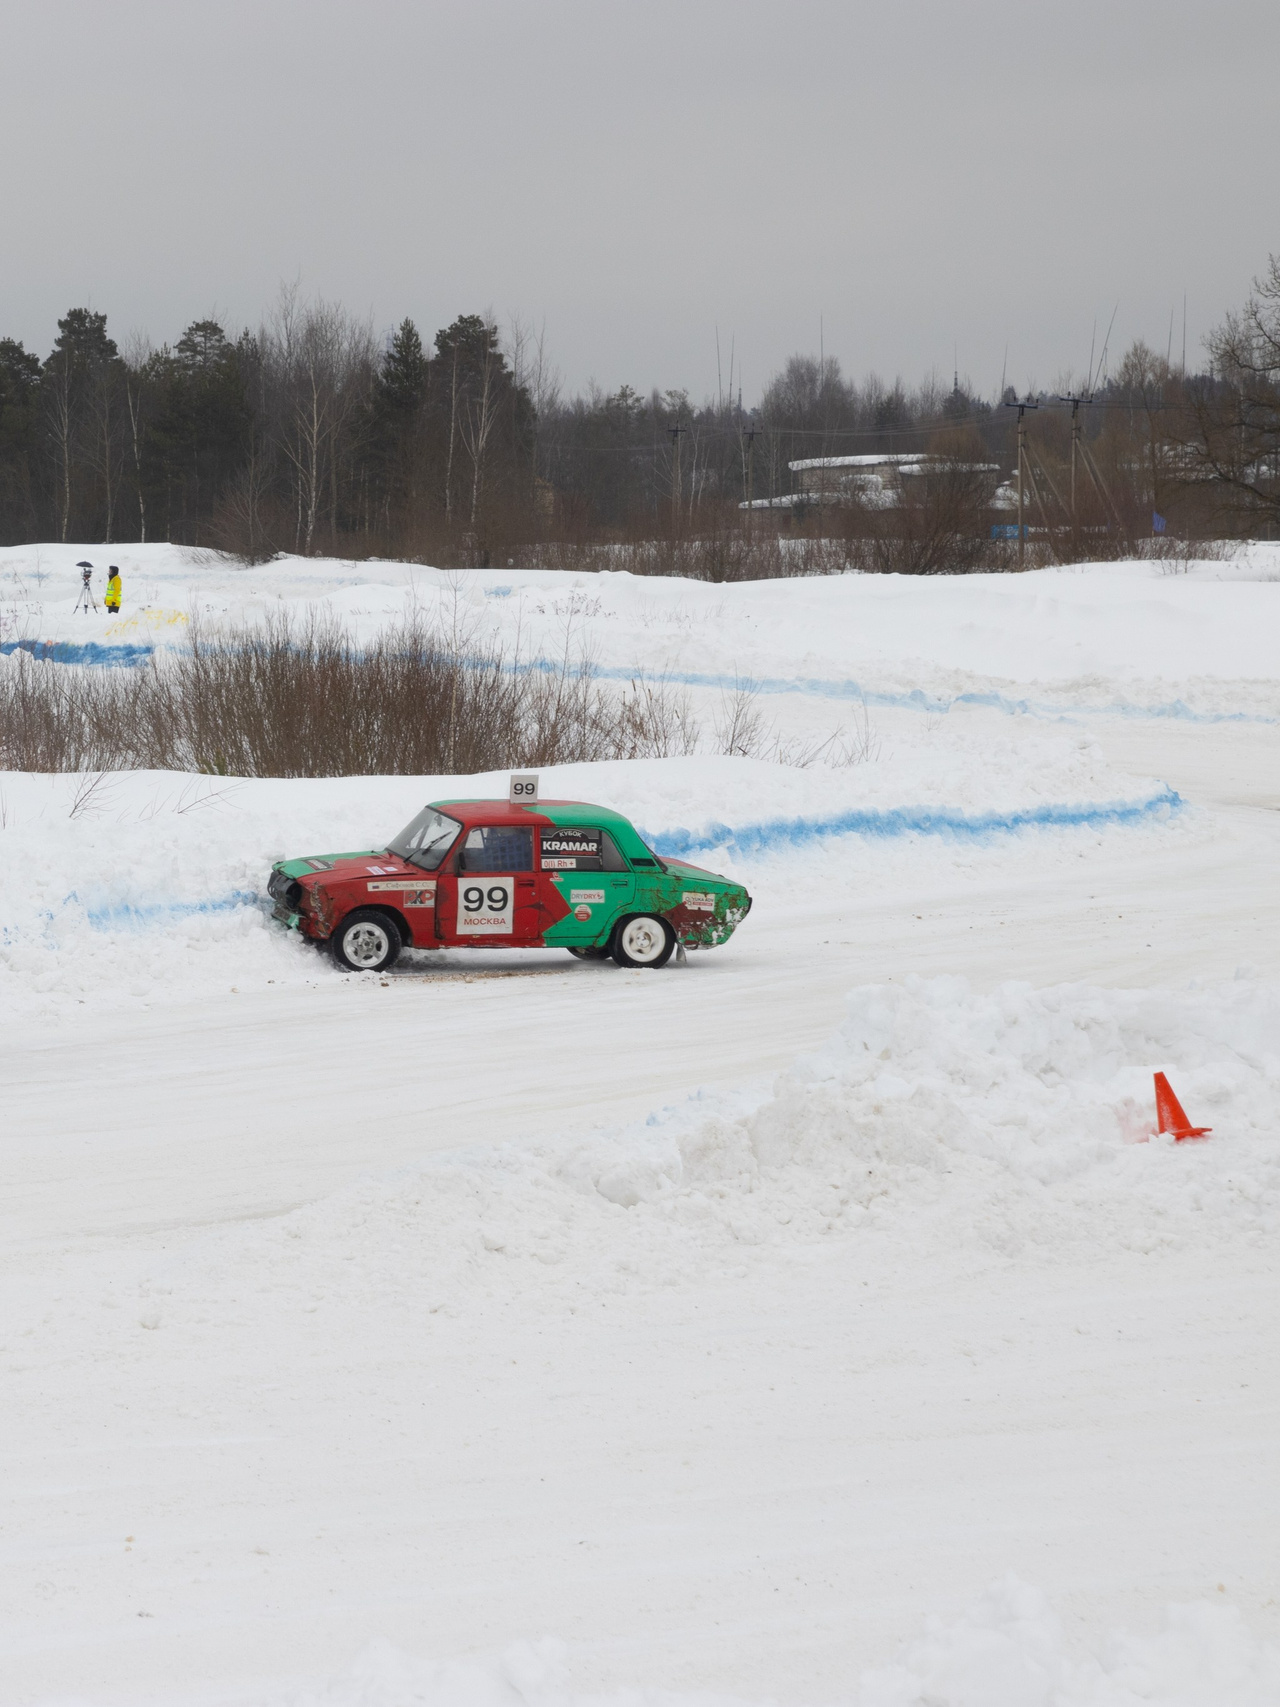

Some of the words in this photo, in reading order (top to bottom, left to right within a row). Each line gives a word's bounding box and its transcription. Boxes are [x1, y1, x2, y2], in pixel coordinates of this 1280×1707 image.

[513, 782, 535, 795] 99
[543, 841, 597, 851] KRAMAR
[463, 886, 509, 912] 99
[463, 917, 506, 926] МОСКВА
